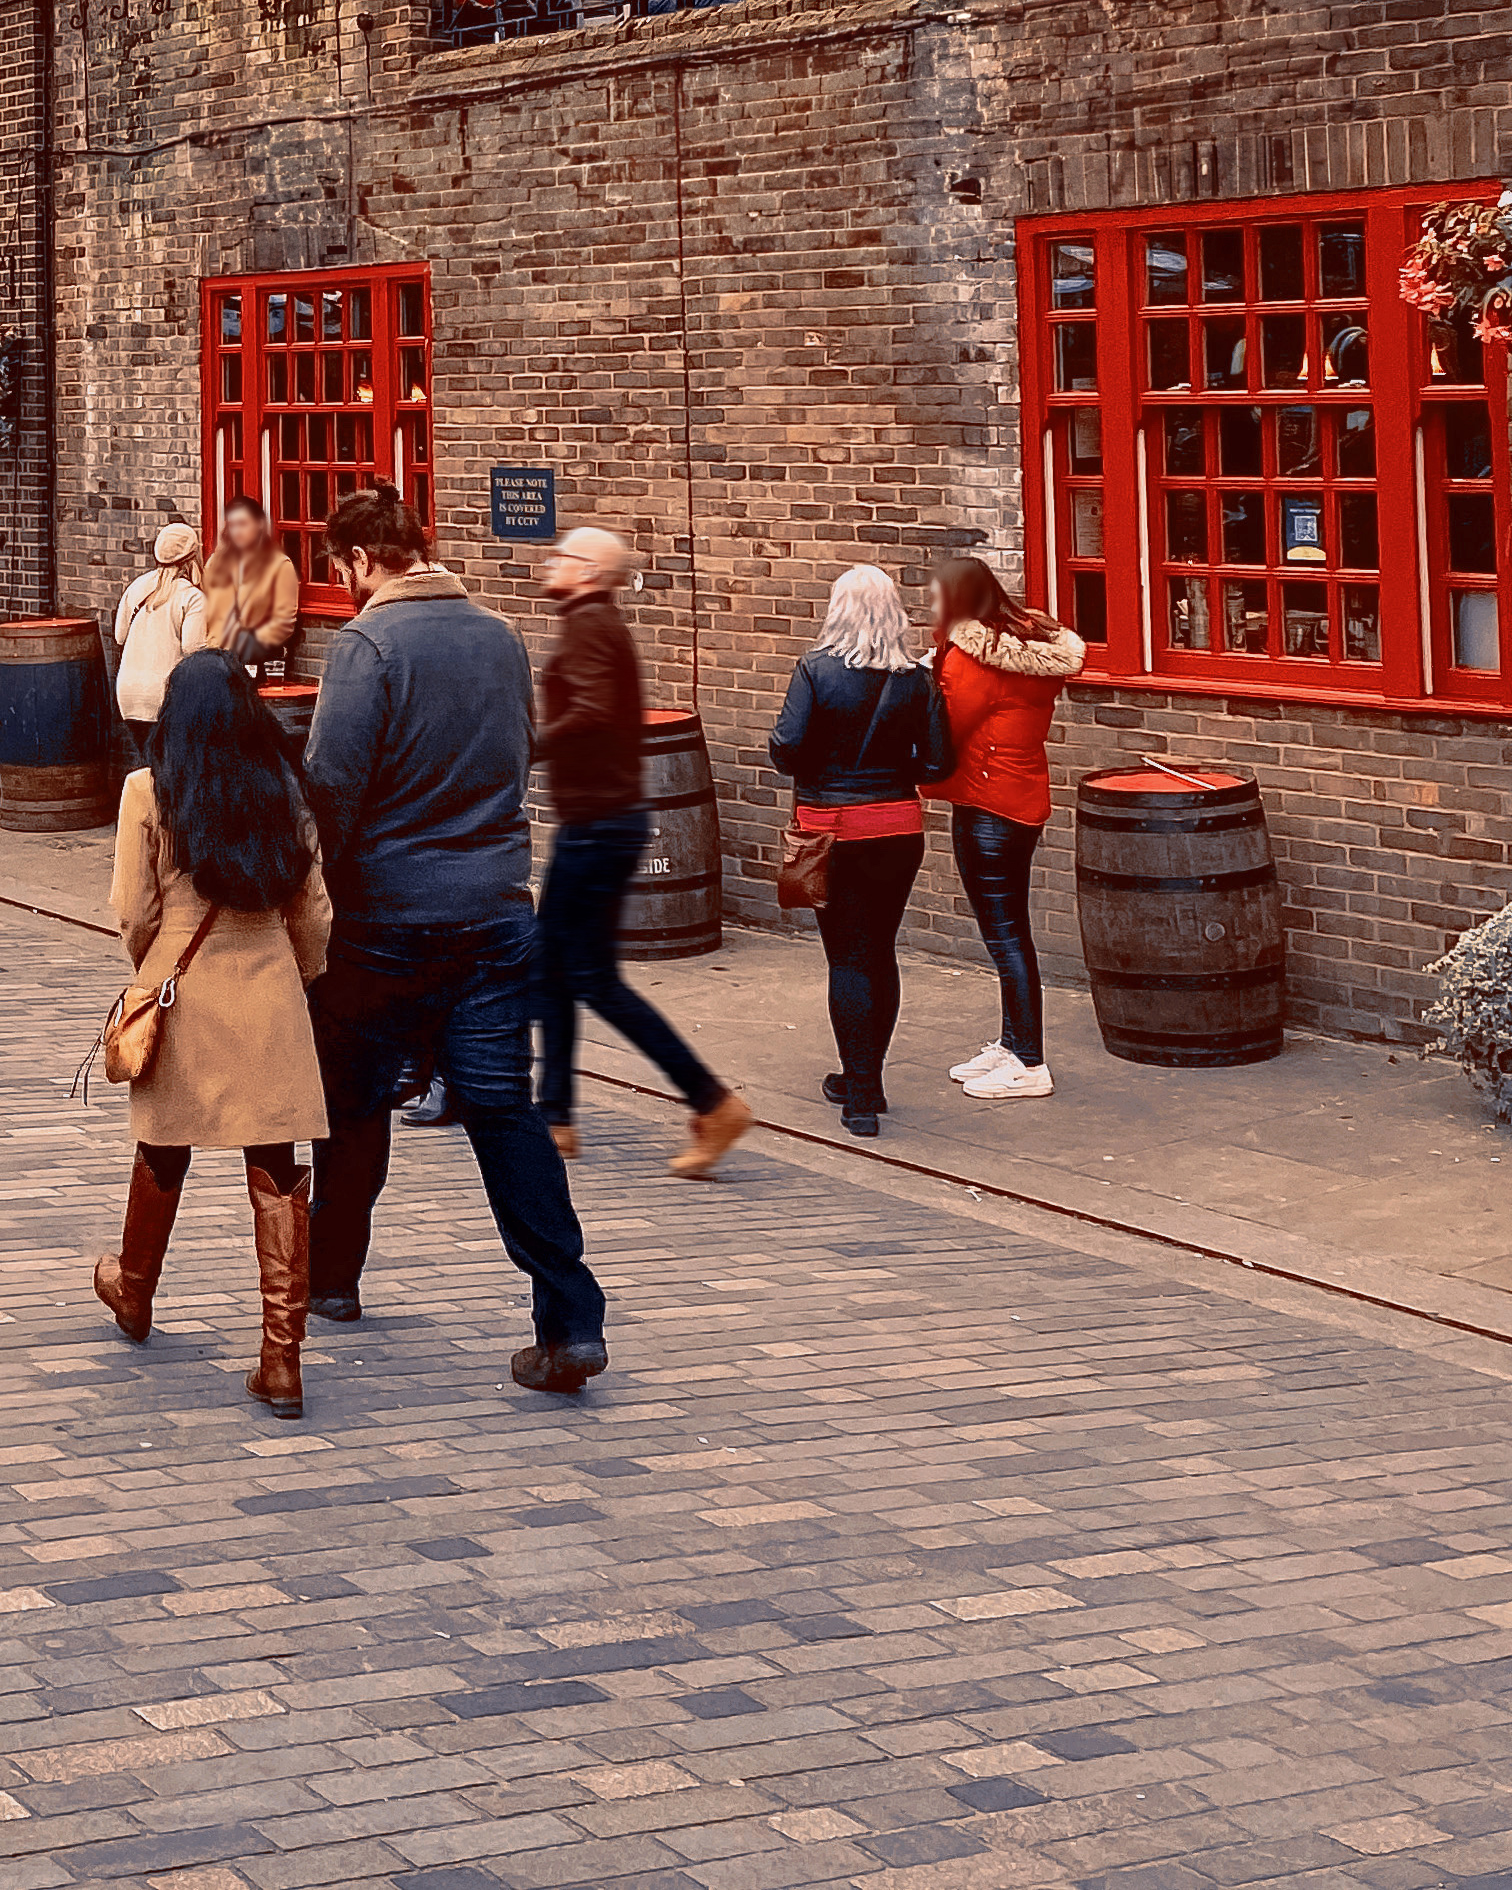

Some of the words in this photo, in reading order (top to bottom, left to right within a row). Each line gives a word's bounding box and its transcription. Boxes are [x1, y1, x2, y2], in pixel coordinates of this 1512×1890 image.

[495, 477, 524, 487] PLEASE
[526, 478, 548, 489] NOTE
[501, 490, 520, 501] THIS
[521, 491, 543, 501] AREA
[499, 503, 507, 513] IS
[508, 504, 546, 514] COVERED
[505, 516, 516, 526] BY
[517, 516, 540, 526] CCTV
